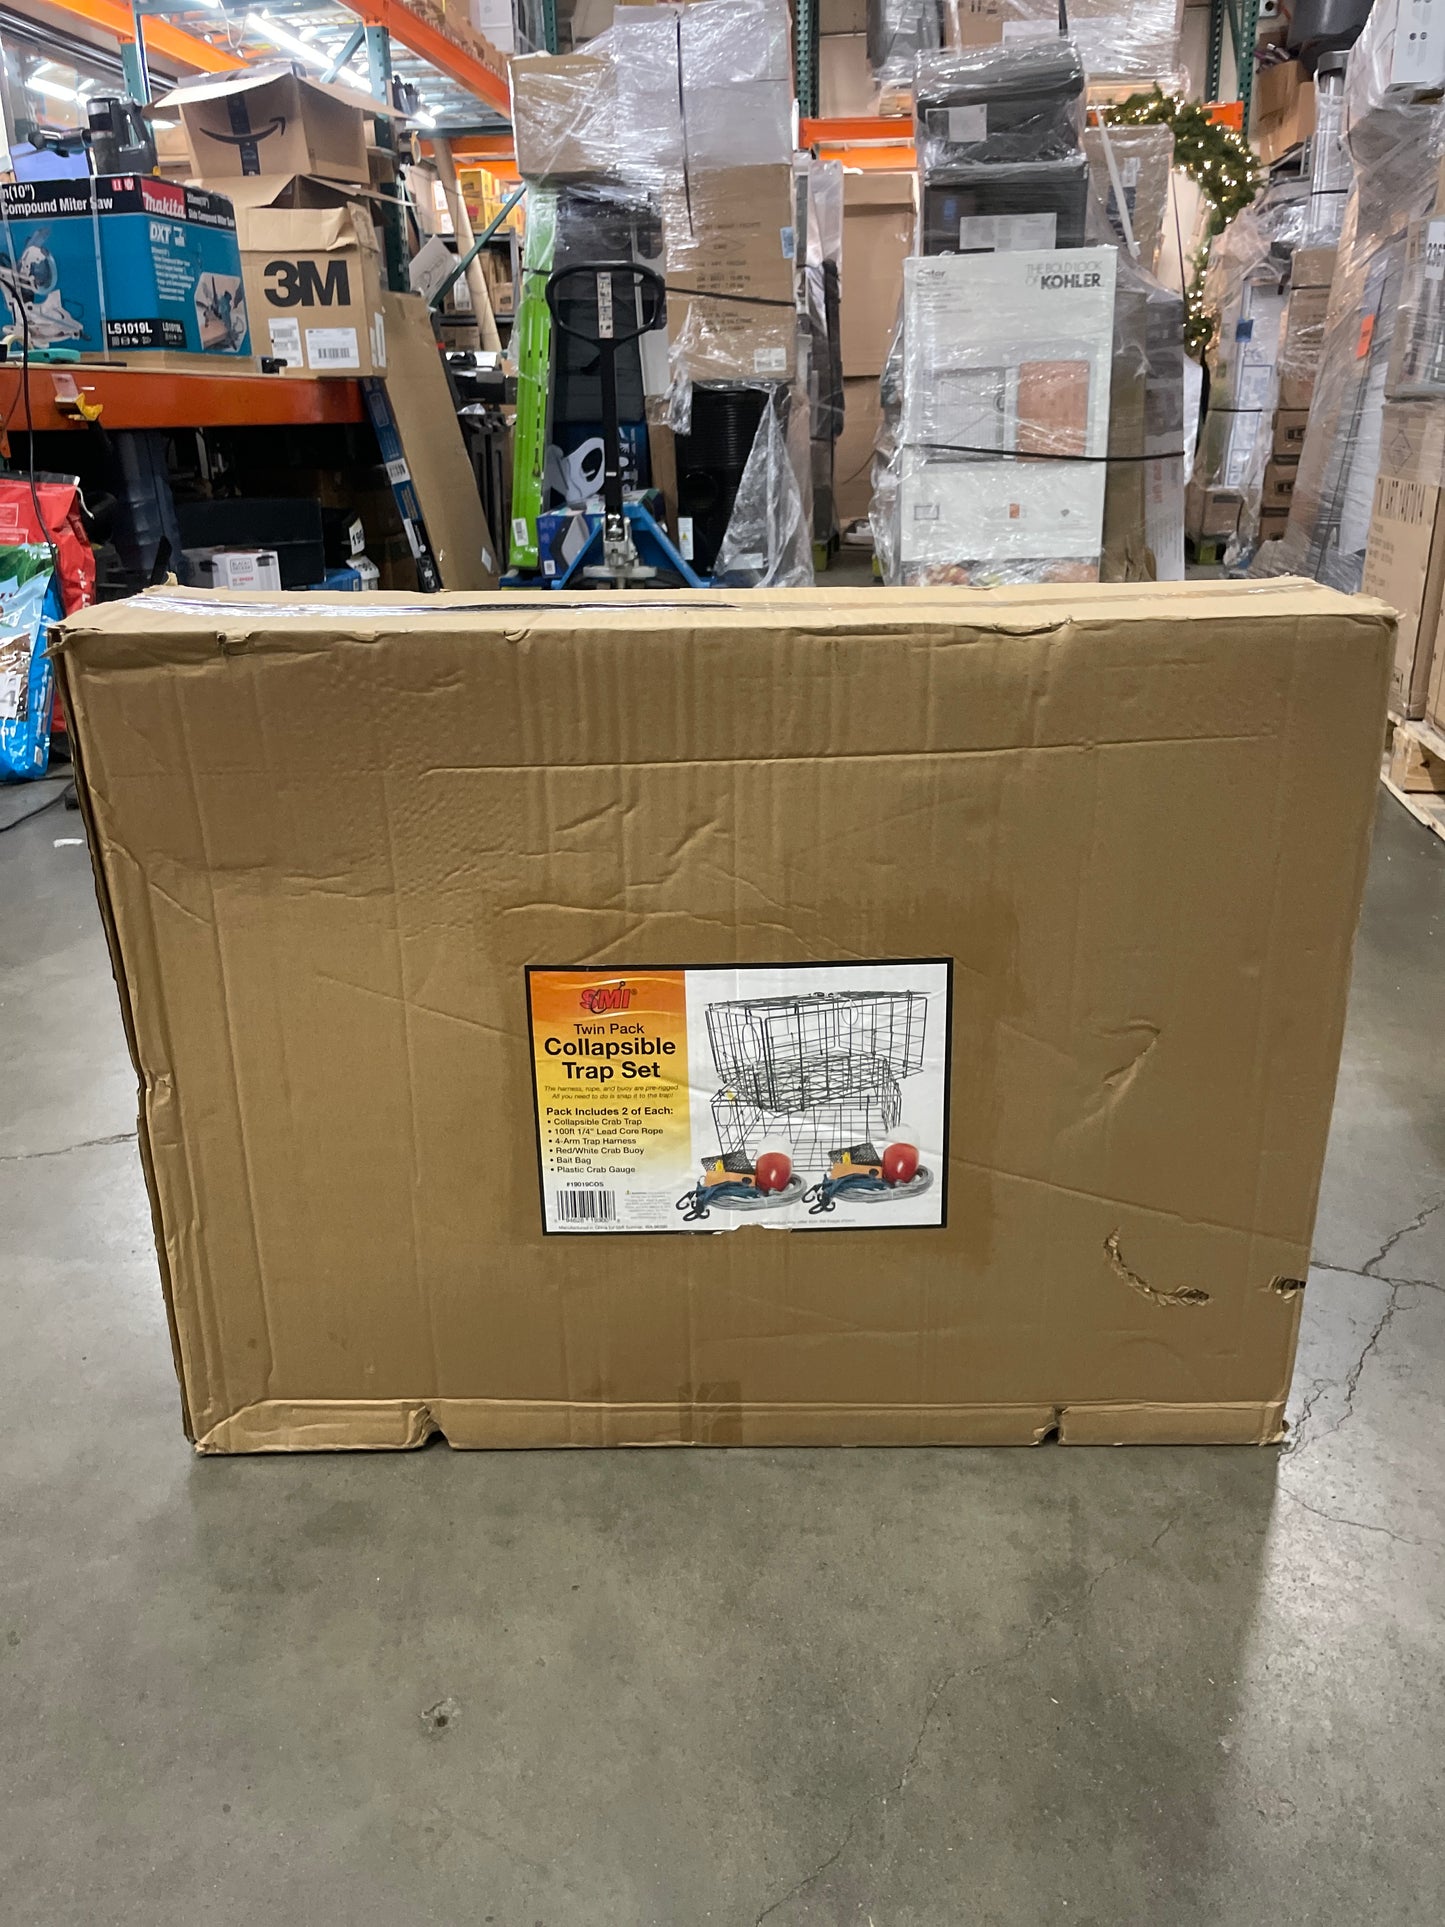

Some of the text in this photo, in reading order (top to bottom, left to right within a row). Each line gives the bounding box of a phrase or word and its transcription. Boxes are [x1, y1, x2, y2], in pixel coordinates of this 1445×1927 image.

[1, 196, 113, 217] Compound Miter Saw
[150, 221, 172, 245] DXT
[1026, 261, 1103, 275] THE BOLD LOOK
[264, 260, 351, 308] 3M
[1041, 273, 1101, 290] KOHLER
[107, 322, 153, 335] LS1019L
[573, 1023, 645, 1035] Twin Pack
[544, 1037, 676, 1059] Collapsible
[562, 1061, 661, 1083] Trap Set
[617, 1085, 632, 1093] buoy
[659, 1092, 674, 1100] trap!
[546, 1106, 674, 1116] Pack Includes 2 of Each:
[553, 1117, 642, 1126] Collapsible Crab Trap
[641, 1128, 663, 1136] Rope
[555, 1137, 580, 1145] 4-Arm
[583, 1137, 601, 1146] Trap
[623, 1146, 645, 1155] Buoy
[575, 1156, 592, 1165] Bag
[609, 1166, 636, 1174] Gauge
